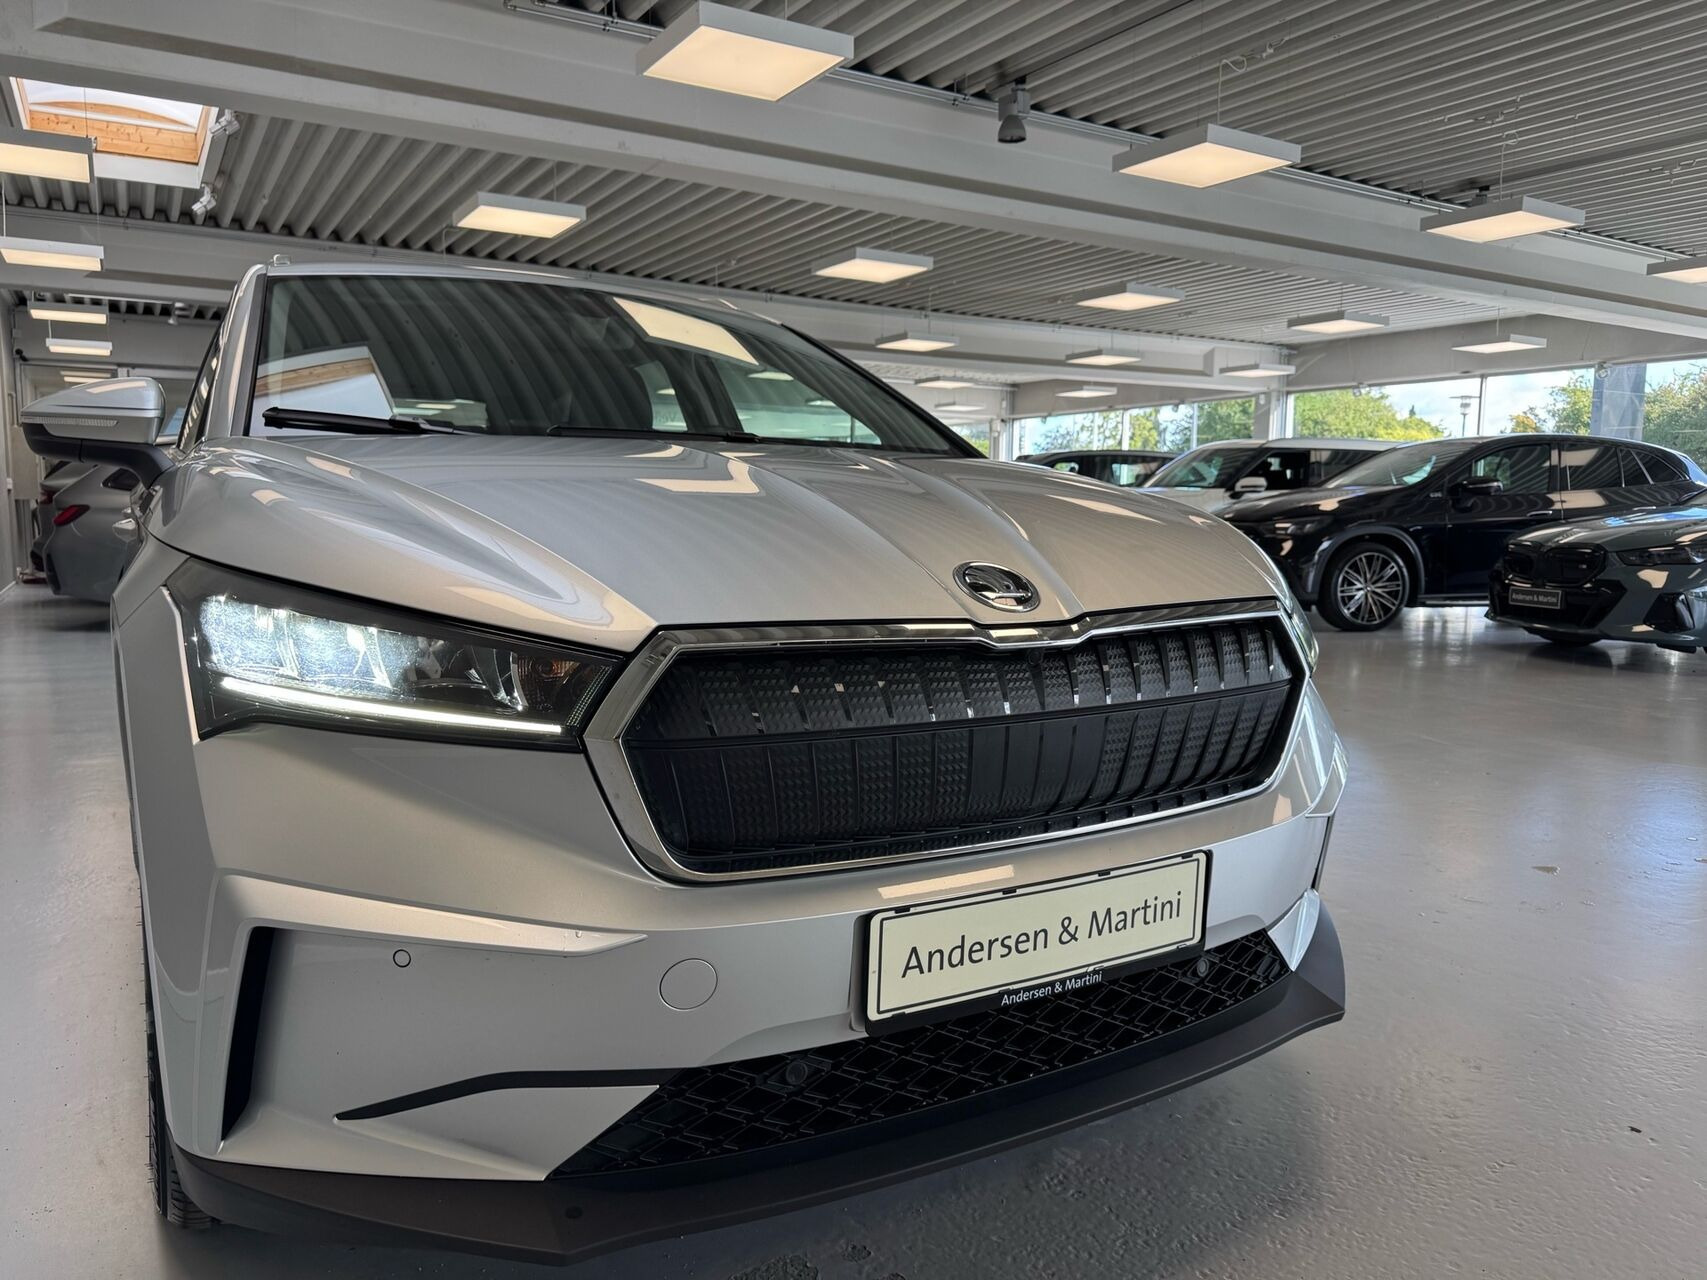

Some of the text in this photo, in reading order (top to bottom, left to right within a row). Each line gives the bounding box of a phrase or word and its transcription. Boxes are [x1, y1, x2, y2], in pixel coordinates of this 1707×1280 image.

[901, 890, 1182, 978] Andersen & Martini
[1001, 971, 1103, 1006] Andersen & Martini
